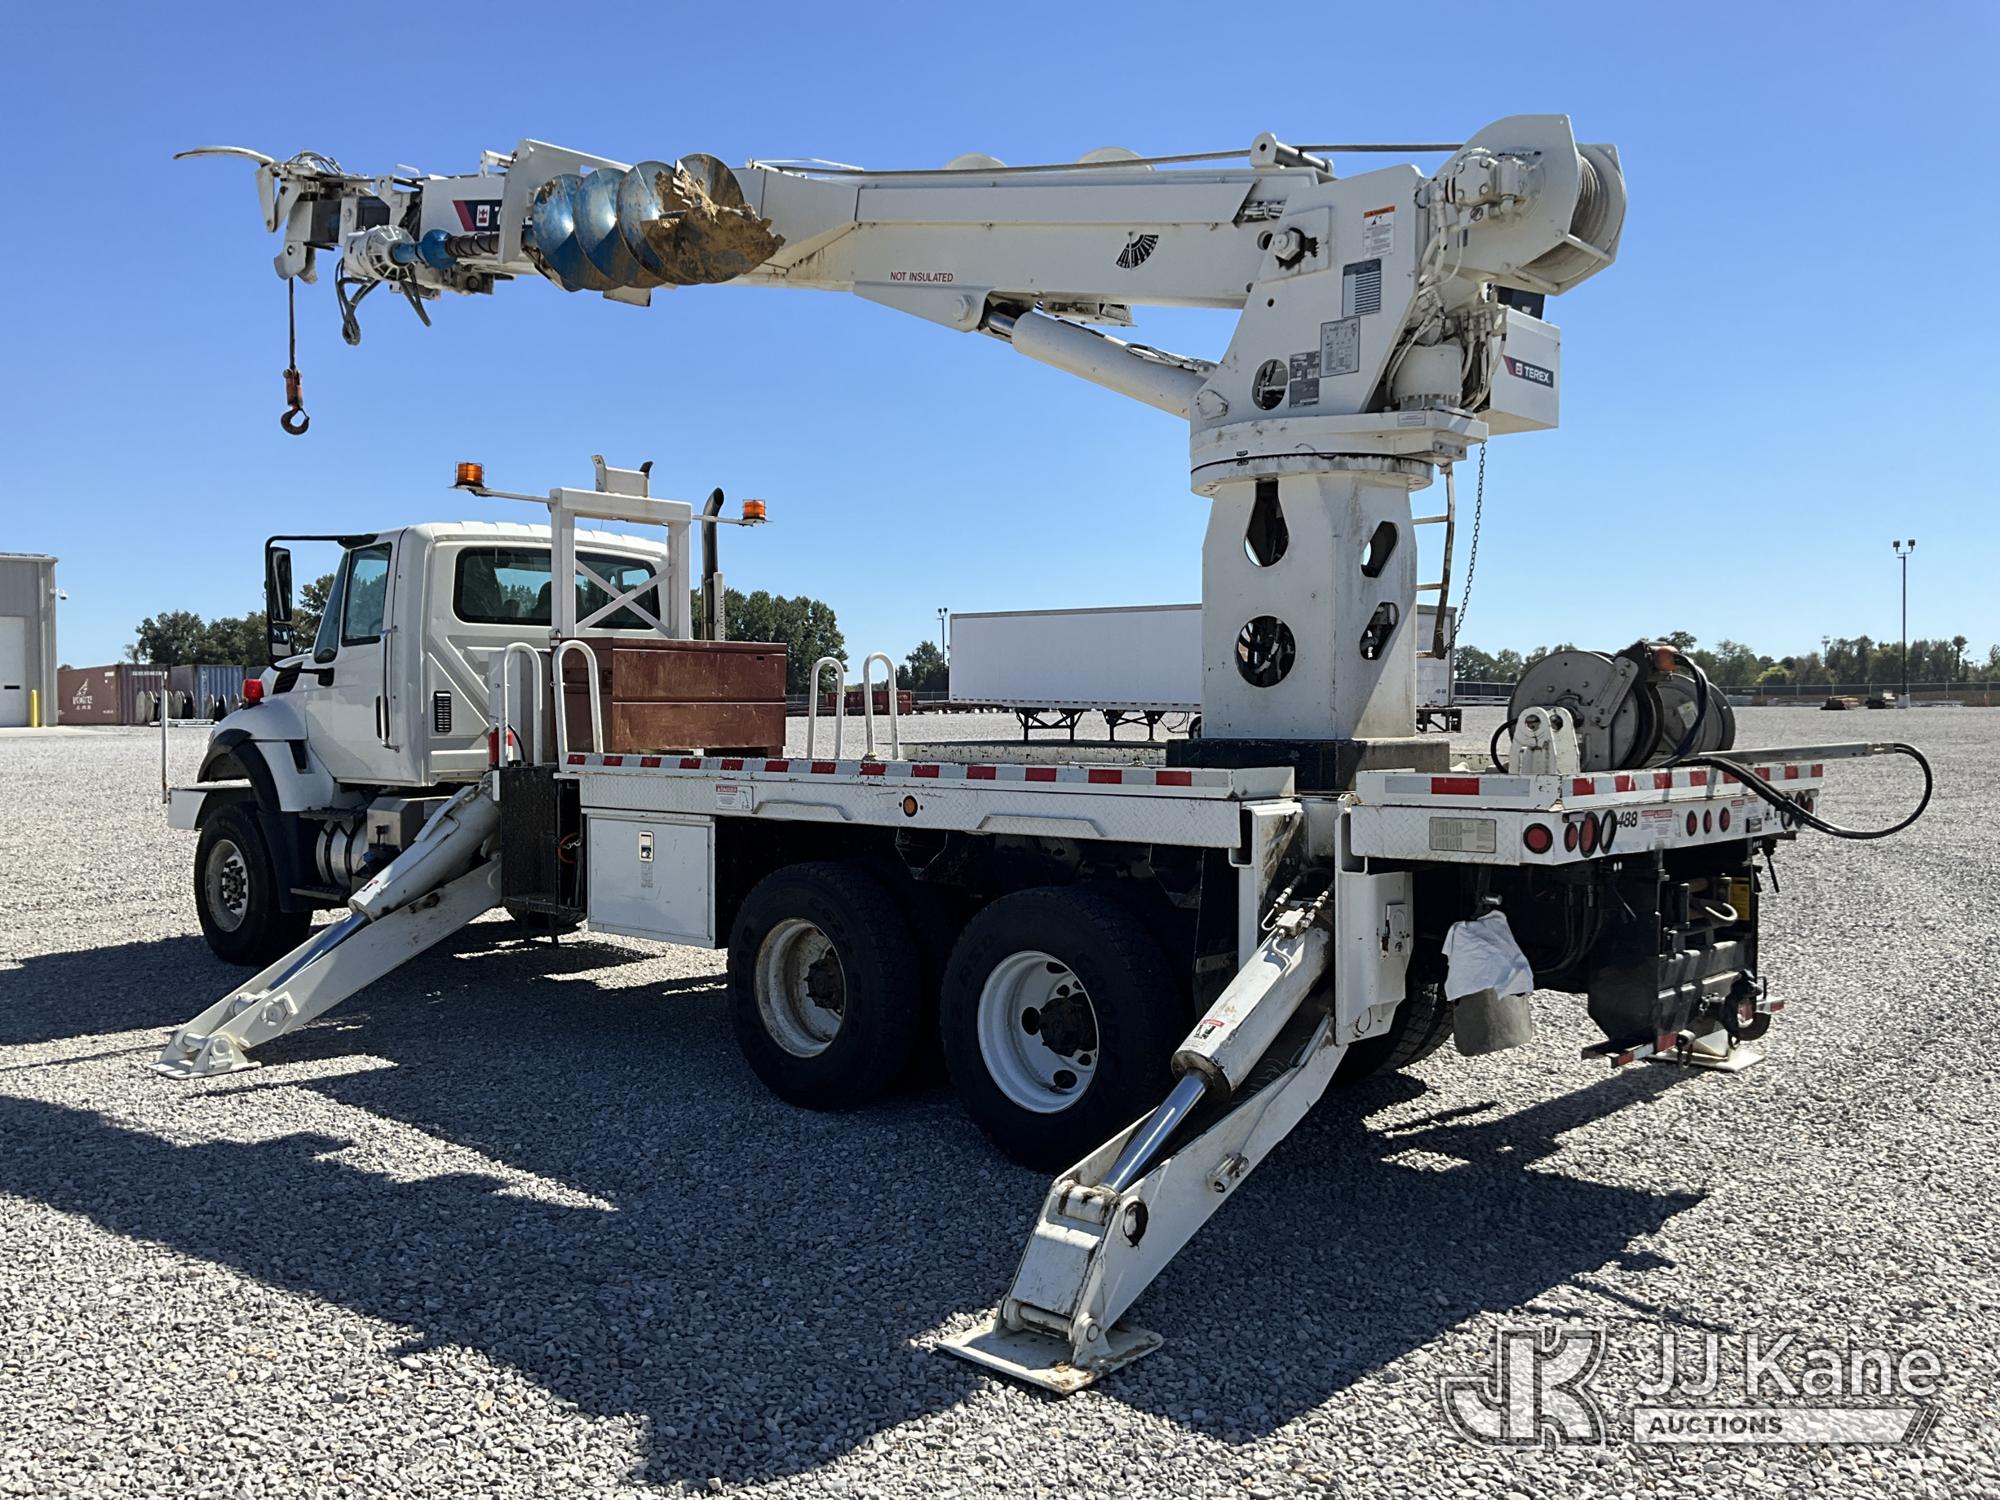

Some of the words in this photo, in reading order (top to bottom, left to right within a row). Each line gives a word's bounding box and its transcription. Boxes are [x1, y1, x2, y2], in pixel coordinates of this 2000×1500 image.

[890, 271, 907, 281] NOT
[909, 271, 954, 283] INSULATED
[1524, 366, 1551, 384] TEREX
